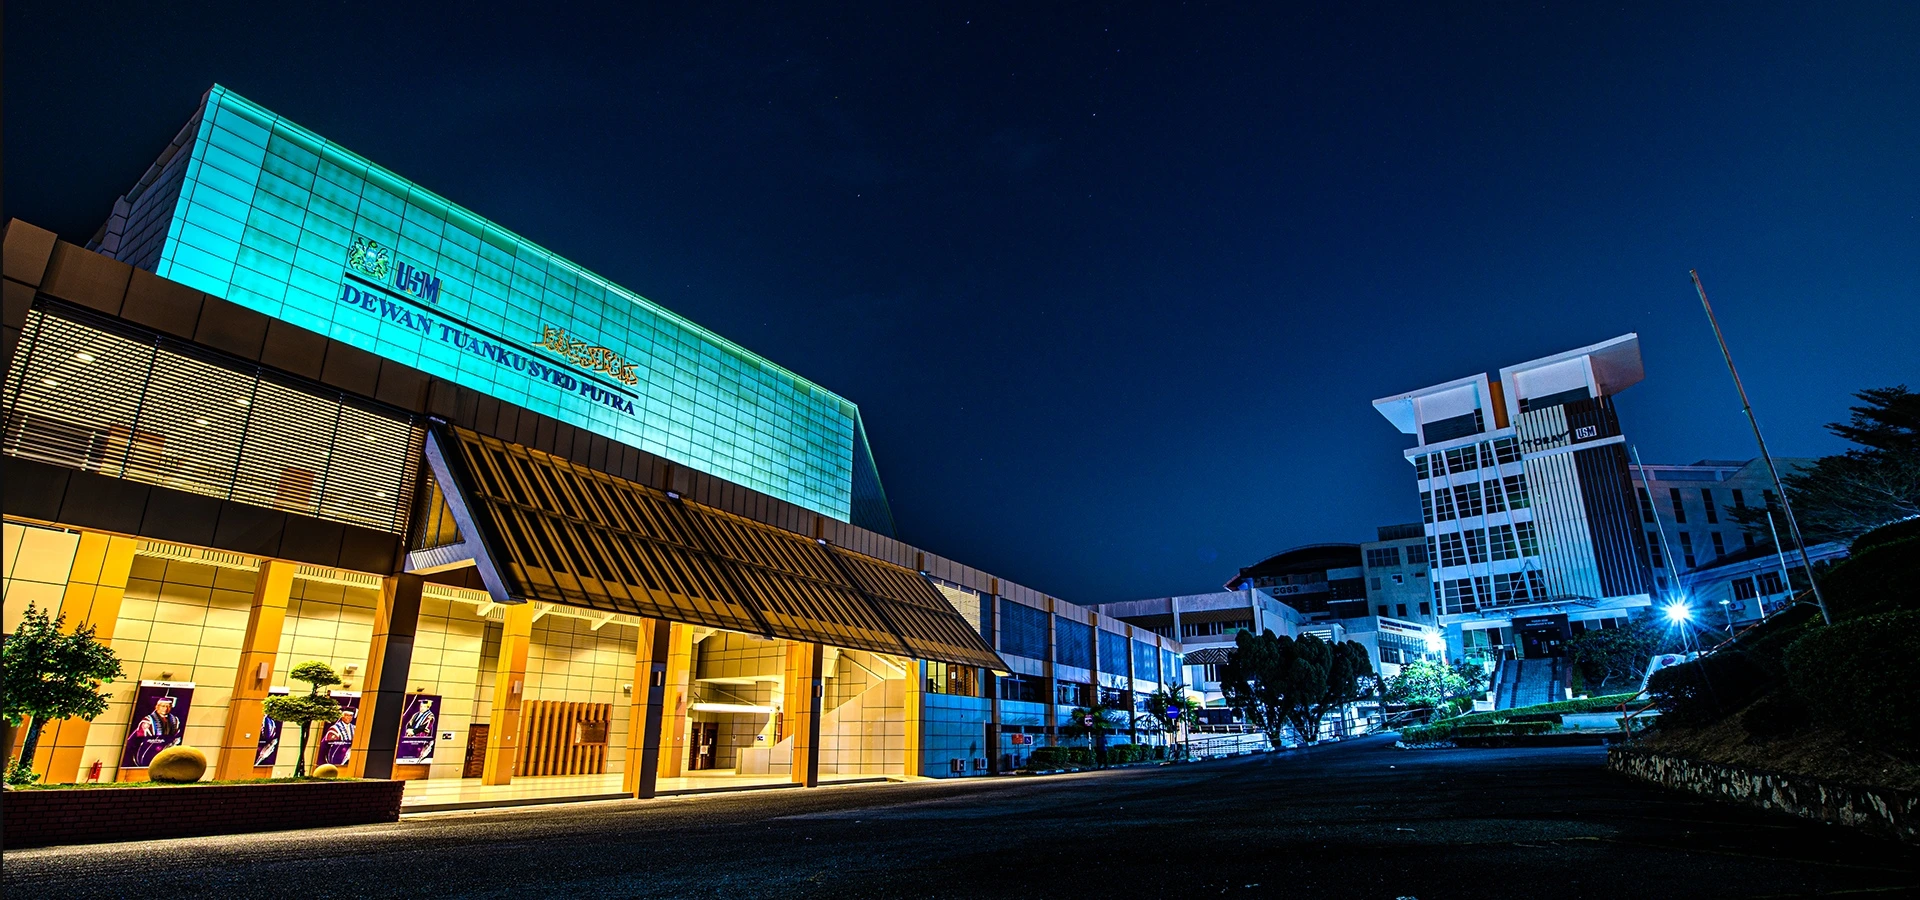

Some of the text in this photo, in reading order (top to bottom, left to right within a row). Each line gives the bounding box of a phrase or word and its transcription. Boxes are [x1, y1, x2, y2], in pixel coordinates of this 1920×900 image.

[396, 261, 441, 304] USM
[340, 282, 635, 416] DEWAN TUANKU SYED PUTRA
[1577, 426, 1596, 438] USM
[1272, 585, 1299, 595] CGSS
